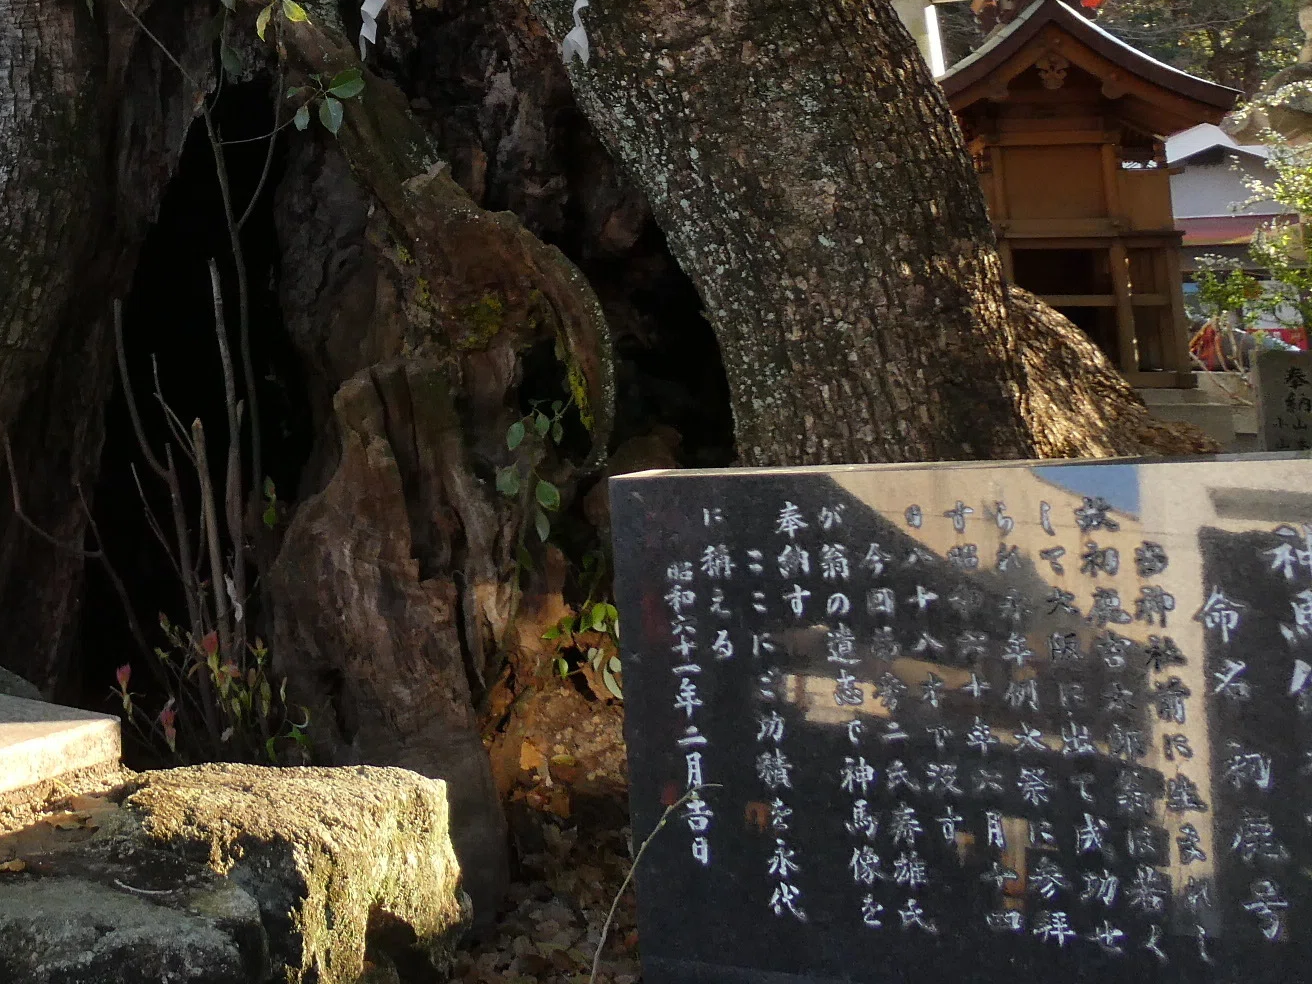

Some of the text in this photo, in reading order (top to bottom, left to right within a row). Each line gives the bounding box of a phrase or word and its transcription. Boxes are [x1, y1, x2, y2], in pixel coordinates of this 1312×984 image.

[775, 501, 810, 617] 奉納す
[1196, 584, 1250, 700] 命名
[664, 562, 713, 864] 昭和六十一年二月吉日
[747, 550, 808, 921] ここにご功績を永代
[1040, 501, 1124, 953] して大阪に出て成功せ
